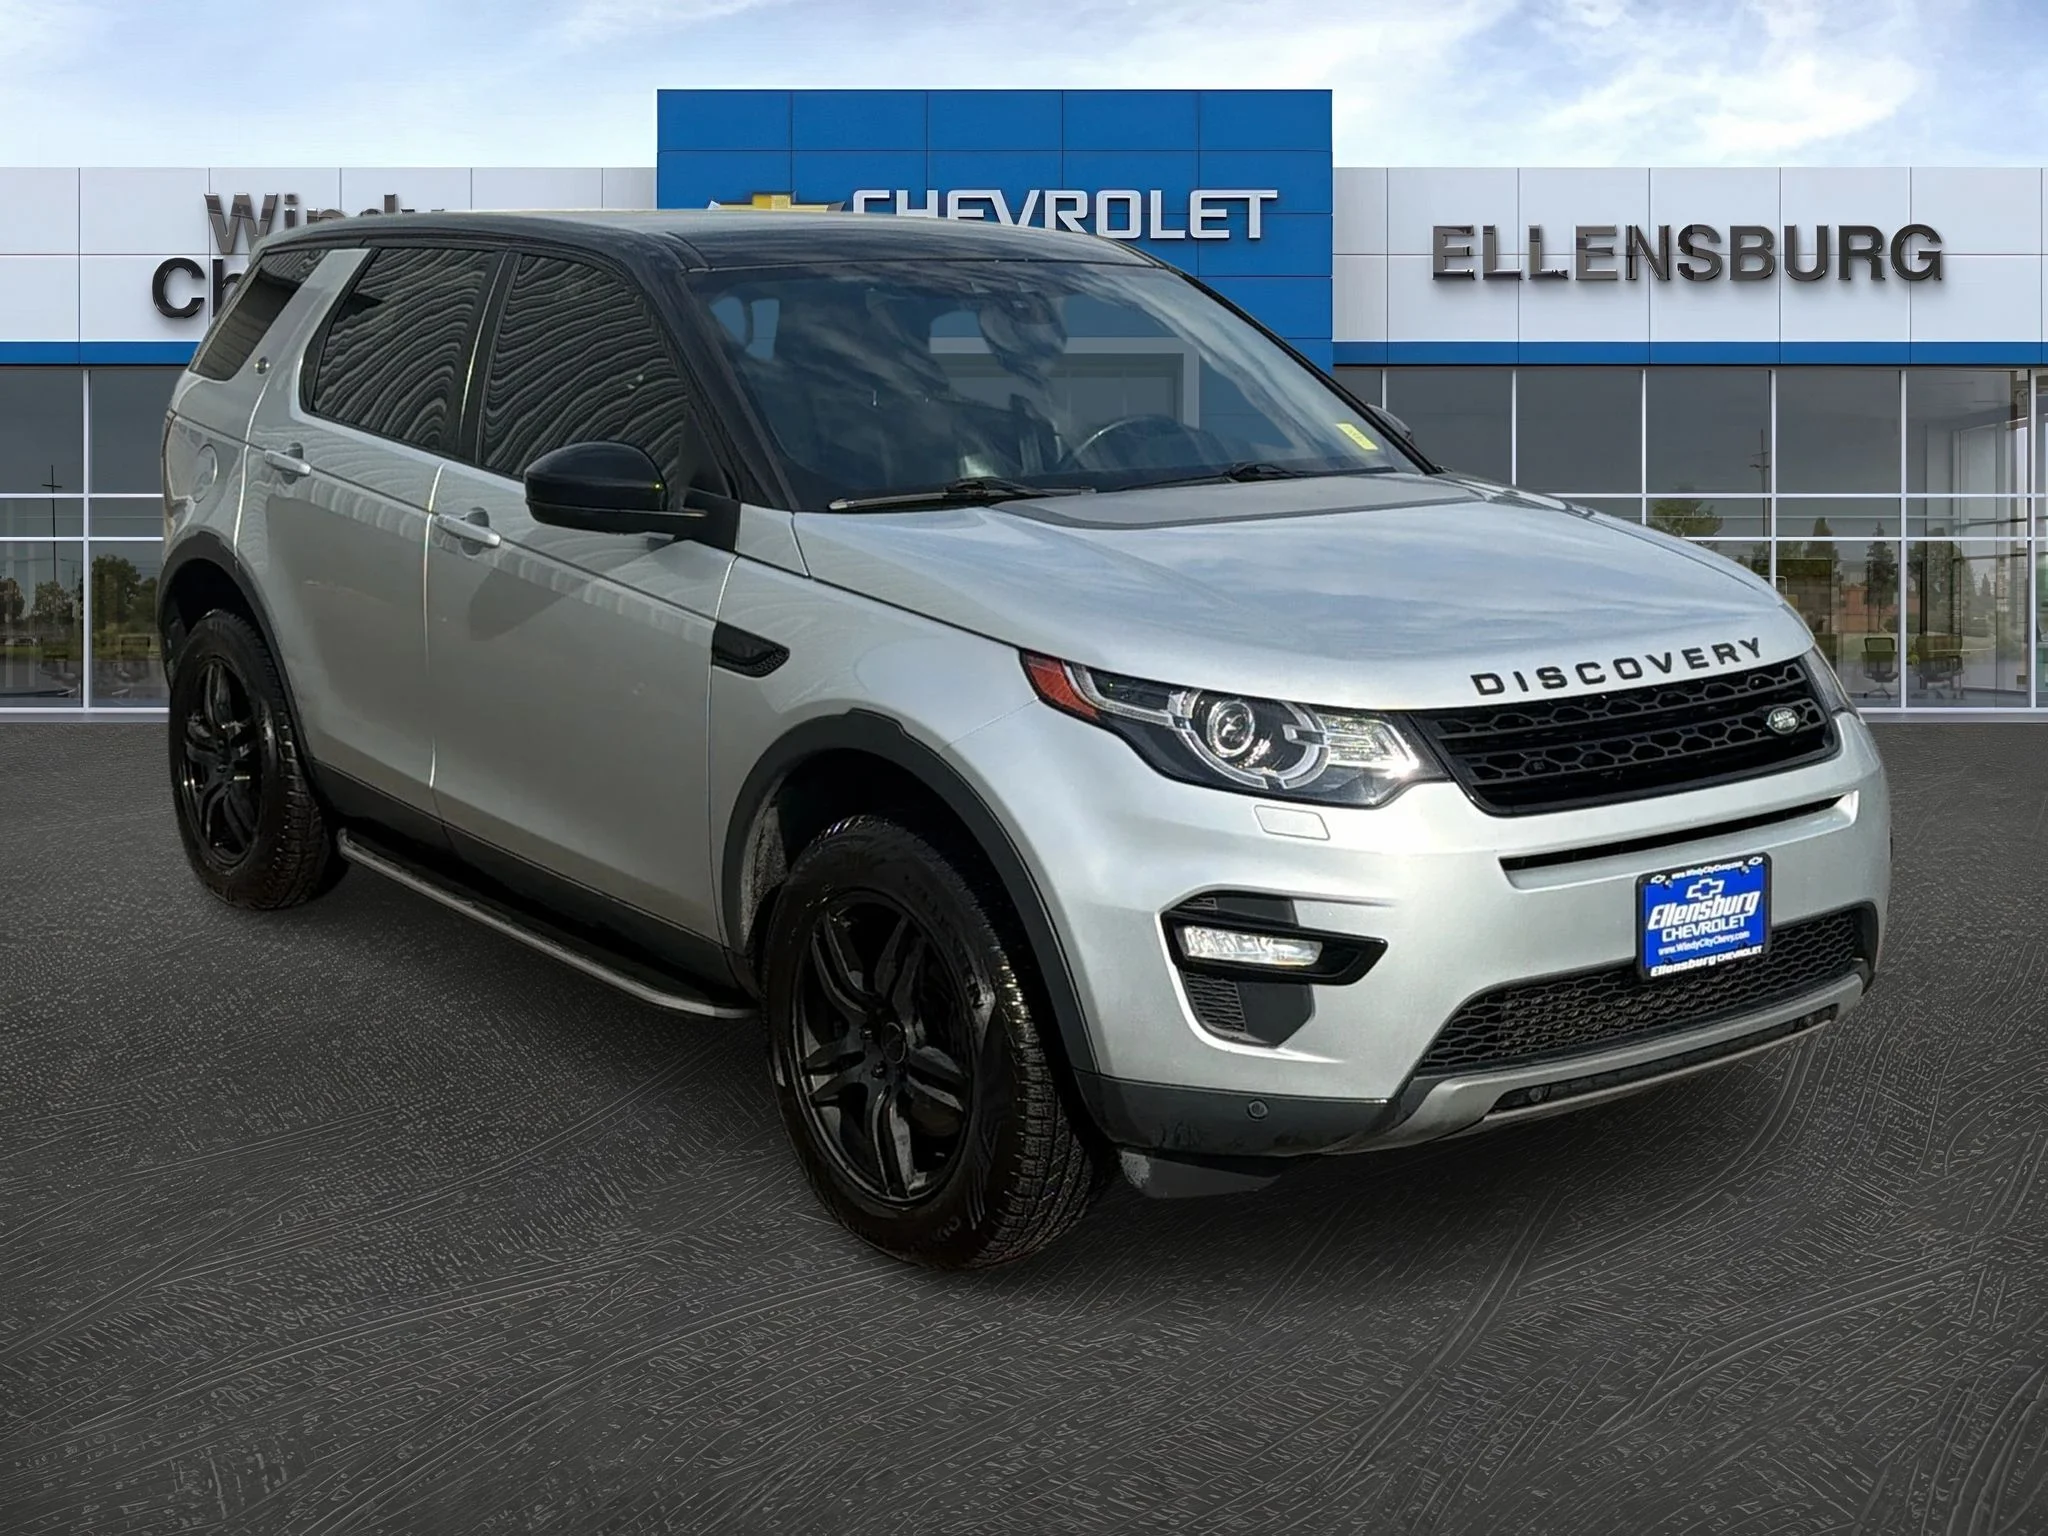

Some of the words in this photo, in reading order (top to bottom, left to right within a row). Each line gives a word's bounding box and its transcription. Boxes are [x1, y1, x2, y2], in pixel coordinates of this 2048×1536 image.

[1431, 223, 1943, 282] ELLENSBURG
[1470, 636, 1761, 696] DISCOVERY
[1647, 890, 1761, 931] Ellensburg
[1661, 914, 1746, 943] CHEVROLET
[1650, 953, 1717, 977] Ellensburg
